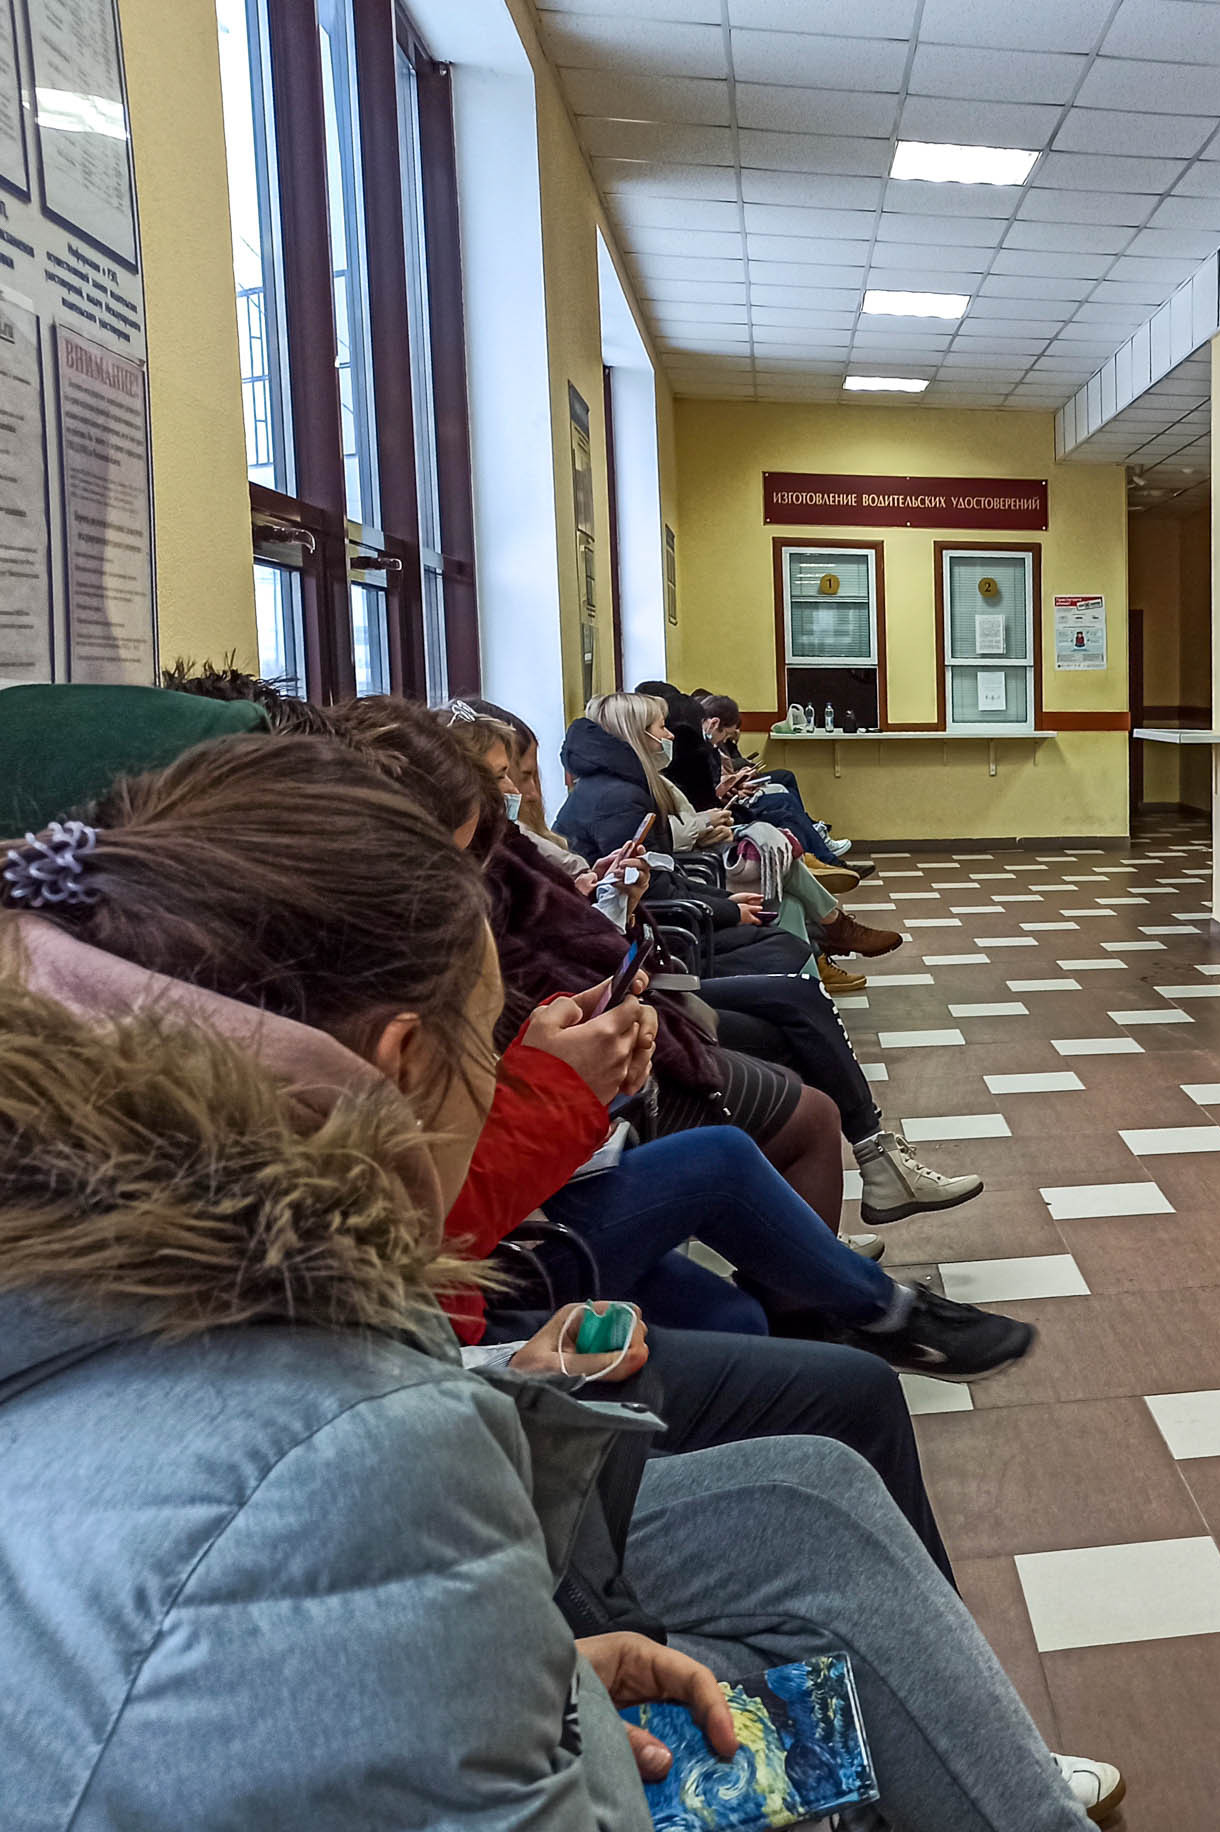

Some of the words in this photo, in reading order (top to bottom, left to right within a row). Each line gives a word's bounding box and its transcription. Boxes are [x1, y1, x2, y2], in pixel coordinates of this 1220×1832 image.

[773, 491, 857, 506] ИЗГОТОВЛЕНИЕ
[862, 494, 946, 508] ВОДИТЕЛЬСКИХ
[951, 496, 1040, 510] УДОСТОВЕРЕНИЙ
[826, 578, 832, 589] 1
[984, 582, 992, 592] 2
